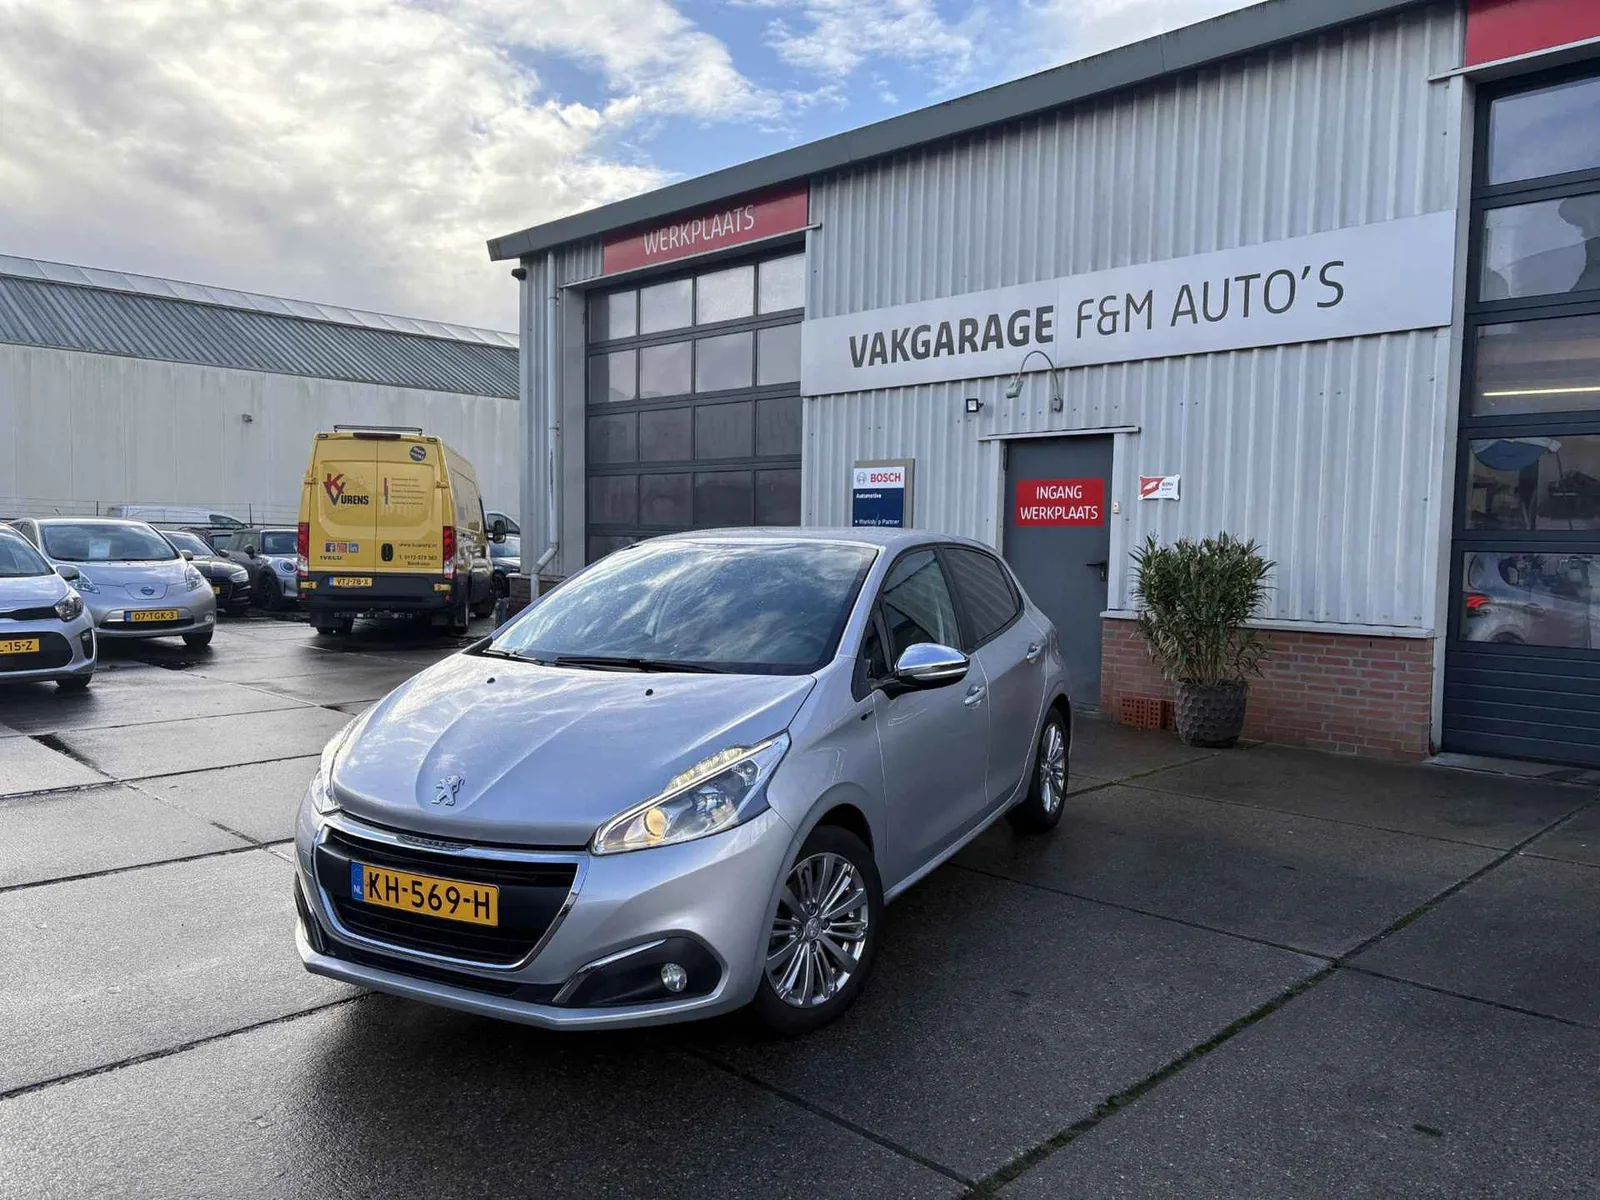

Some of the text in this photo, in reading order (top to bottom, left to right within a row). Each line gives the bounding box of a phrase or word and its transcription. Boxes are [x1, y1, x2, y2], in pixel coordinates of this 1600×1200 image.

[643, 204, 755, 256] WERKPLAATS
[848, 260, 1345, 368] VAKGARAGE F&M AUTO'S
[870, 472, 901, 483] BOSCH
[1036, 484, 1083, 500] INGANG
[1020, 505, 1099, 520] WERKPLAATS
[134, 611, 175, 621] 07-TGK-3
[353, 884, 363, 895] NL
[369, 871, 491, 920] KH-569-H
